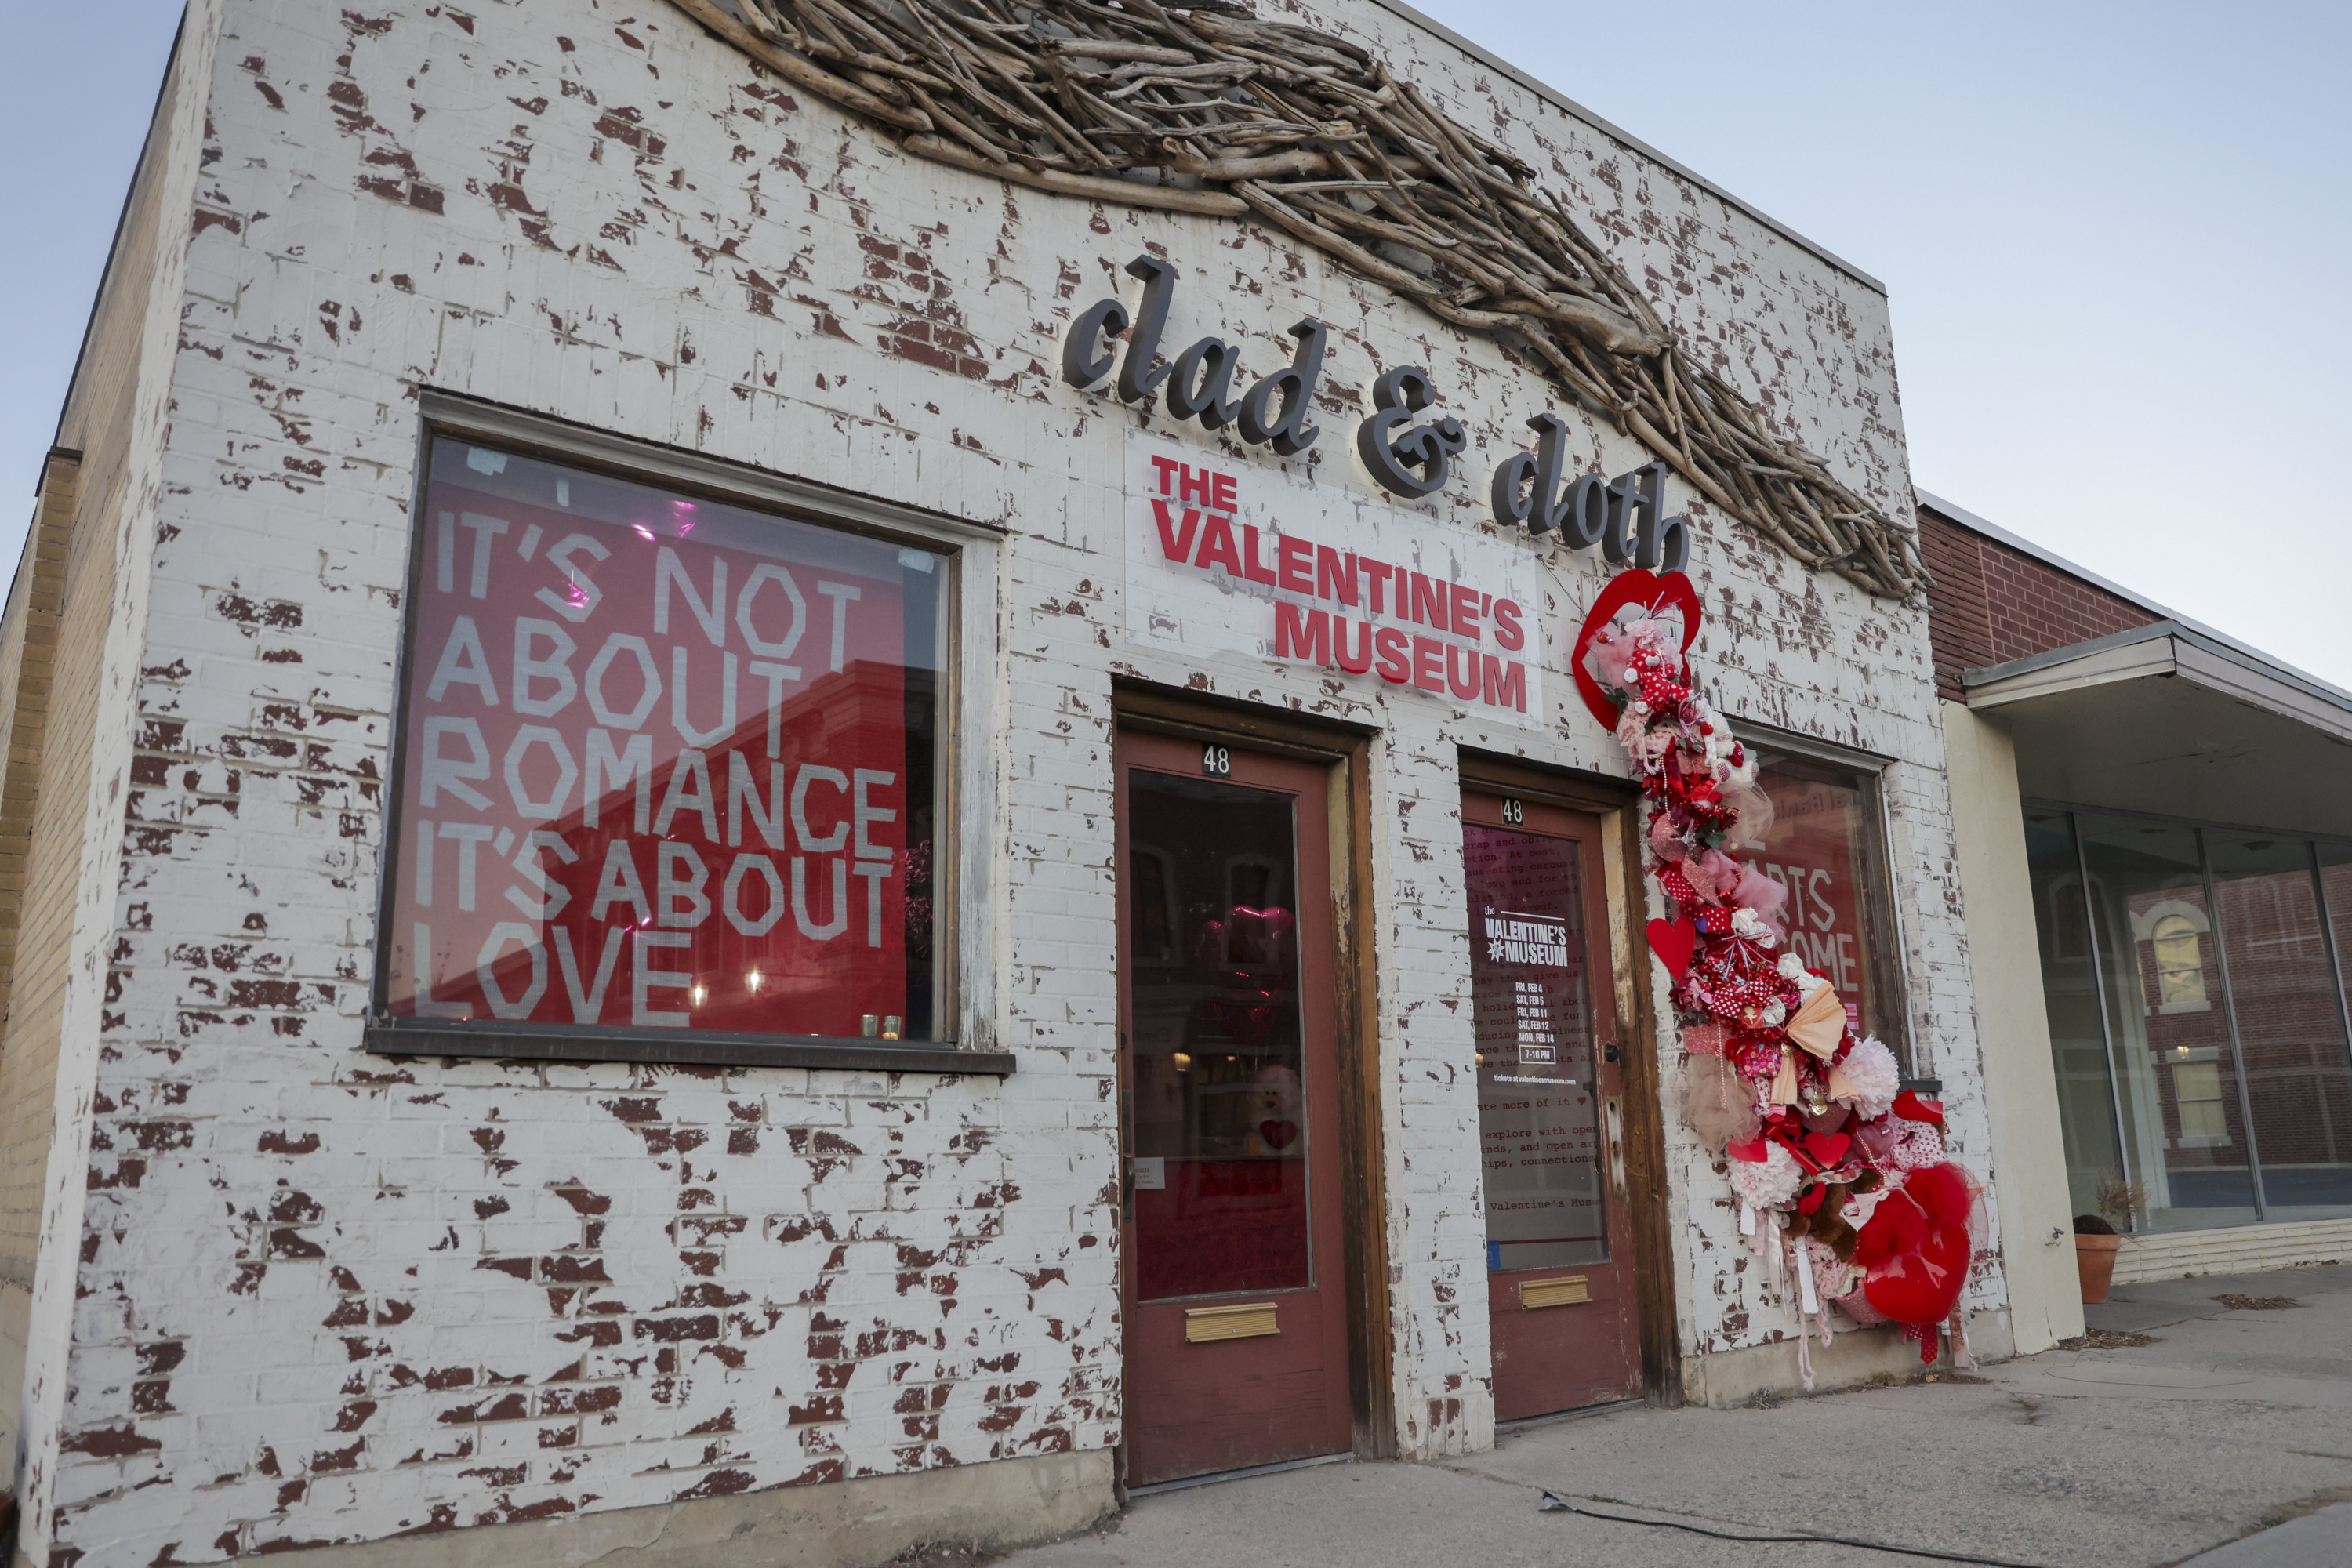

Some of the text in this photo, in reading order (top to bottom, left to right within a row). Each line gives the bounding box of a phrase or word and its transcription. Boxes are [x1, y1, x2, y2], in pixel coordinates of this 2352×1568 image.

[1062, 254, 1690, 577] clad & cloth
[1152, 455, 1237, 513] THE
[1151, 499, 1523, 651] VALENTINE'S
[437, 511, 862, 674] IT'S NOT
[1275, 601, 1526, 713] MUSEUM
[426, 615, 800, 759] ABOUT
[1203, 746, 1229, 773] 48
[419, 716, 897, 859] ROMANCE
[1503, 798, 1523, 822] 48
[1496, 837, 1515, 847] and
[1509, 851, 1523, 859] At
[1530, 848, 1560, 858] best,
[415, 820, 893, 948] IT'S ABOUT
[1512, 877, 1531, 886] and
[1538, 874, 1557, 884] for
[1468, 893, 1518, 903] ulaton,
[1539, 886, 1578, 897] forced
[1737, 859, 1835, 931] RTS
[1485, 906, 1495, 916] the
[1485, 918, 1566, 946] VALENTINE'S
[1504, 940, 1568, 967] MUSEUM
[1781, 931, 1859, 992] OME
[413, 921, 692, 1028] LOVE
[1474, 977, 1493, 986] Day
[1501, 974, 1526, 983] that
[1533, 971, 1559, 982] give
[1515, 982, 1527, 993] FRI,
[1528, 982, 1538, 993] FEB
[1538, 983, 1543, 993] 4
[1516, 995, 1544, 1006] SAT, FEB 5
[1517, 1007, 1548, 1018] FRI, FEB 11
[1518, 1019, 1549, 1031] SAT, FEB 12
[1475, 1031, 1517, 1041] ducing
[1519, 1032, 1555, 1044] MON, FEB 14
[1566, 1040, 1585, 1048] and
[1526, 1048, 1551, 1059] 7-10 PM
[1494, 1073, 1512, 1082] tickets
[1519, 1075, 1576, 1085] valentinesmuseum.com
[1503, 1101, 1530, 1109] more
[1537, 1098, 1549, 1107] of
[1557, 1098, 1570, 1106] it
[1485, 1129, 1532, 1140] explore
[1538, 1127, 1566, 1136] with
[1520, 1142, 1540, 1152] and
[1547, 1142, 1573, 1152] open
[1521, 1155, 1595, 1166] connections
[1490, 1200, 1565, 1210] Valentine's
